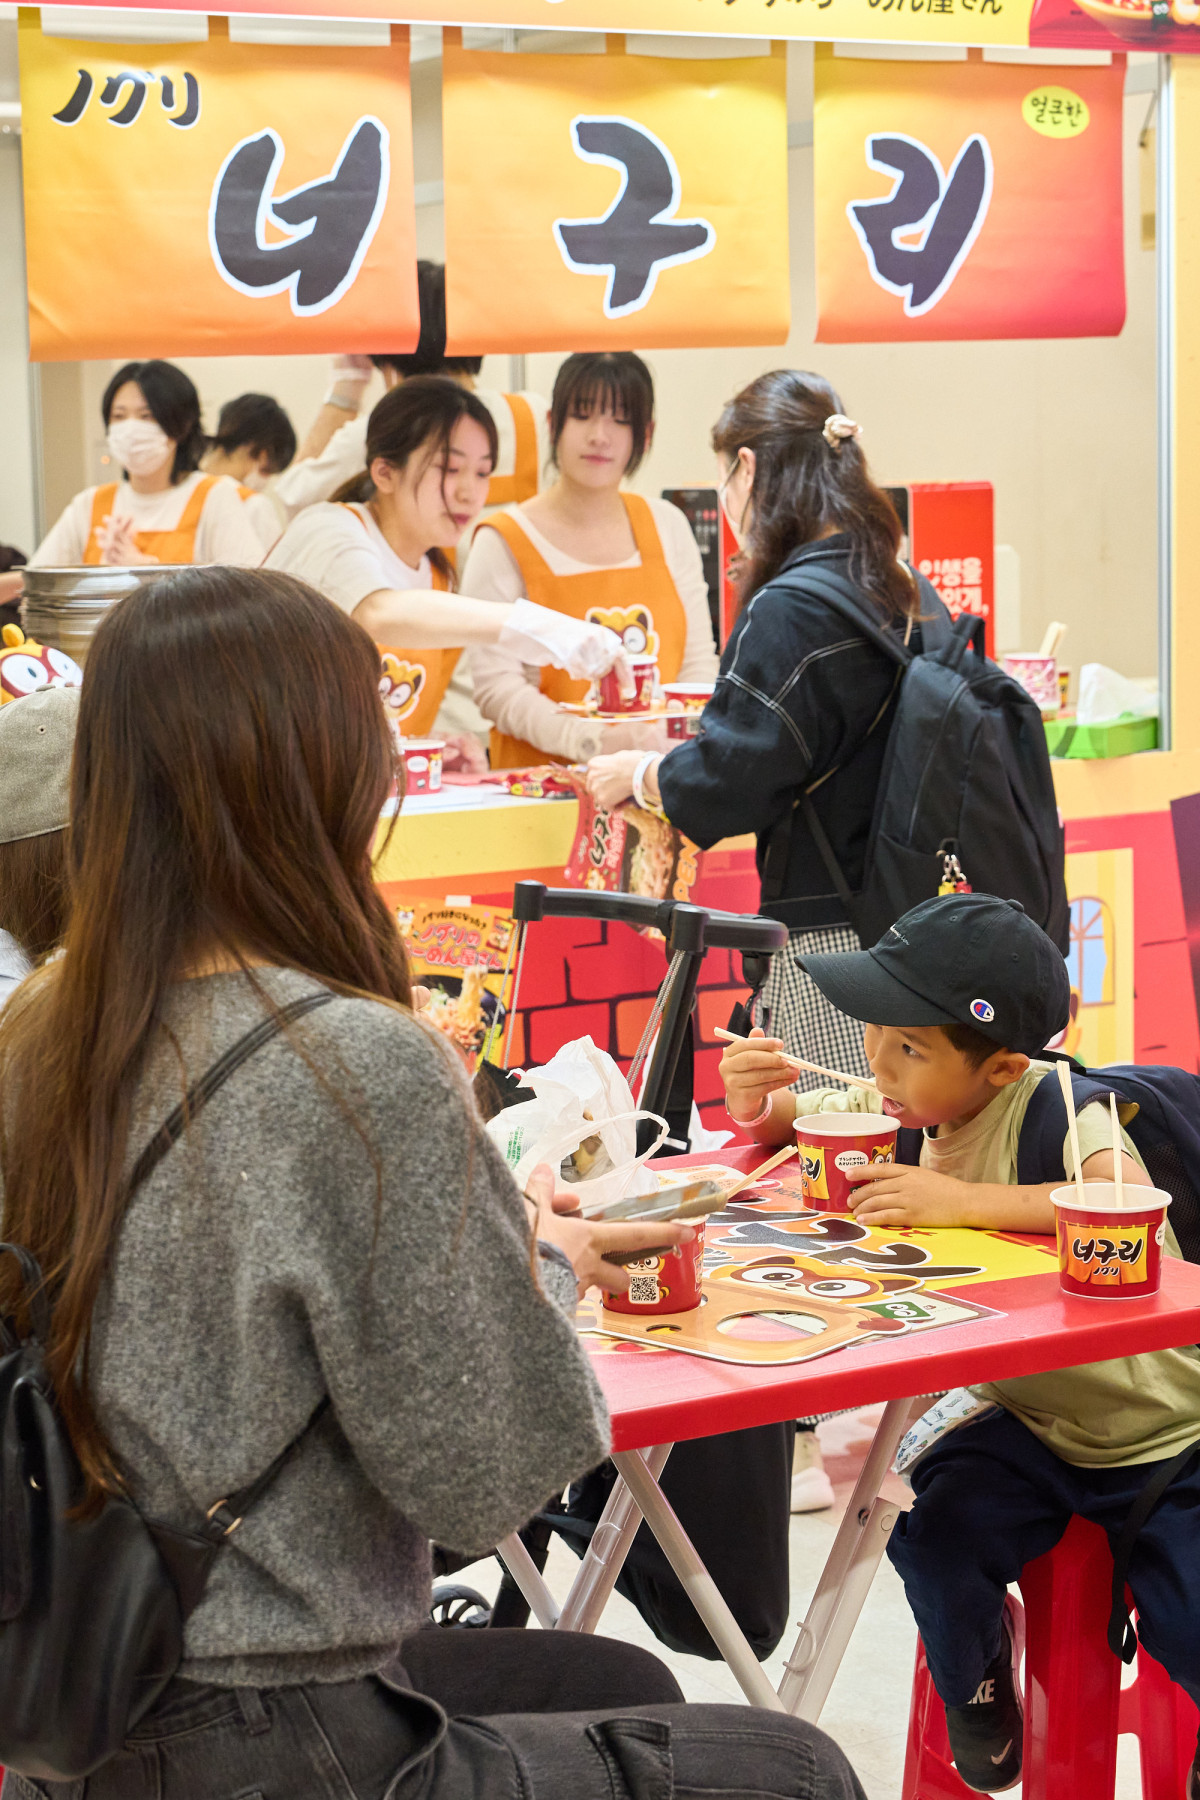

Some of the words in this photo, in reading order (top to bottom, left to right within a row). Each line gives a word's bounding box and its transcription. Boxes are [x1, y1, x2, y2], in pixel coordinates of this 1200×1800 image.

[52, 68, 201, 129] ノグリ
[1030, 95, 1083, 128] 얼큰한
[935, 586, 989, 617] 있게,
[672, 831, 702, 902] PEN
[420, 922, 481, 946] ノグリの
[405, 940, 502, 969] ーめん屋さん
[1072, 1237, 1144, 1266] 너구리
[1092, 1266, 1120, 1276] ノグリ
[966, 1678, 996, 1705] KE
